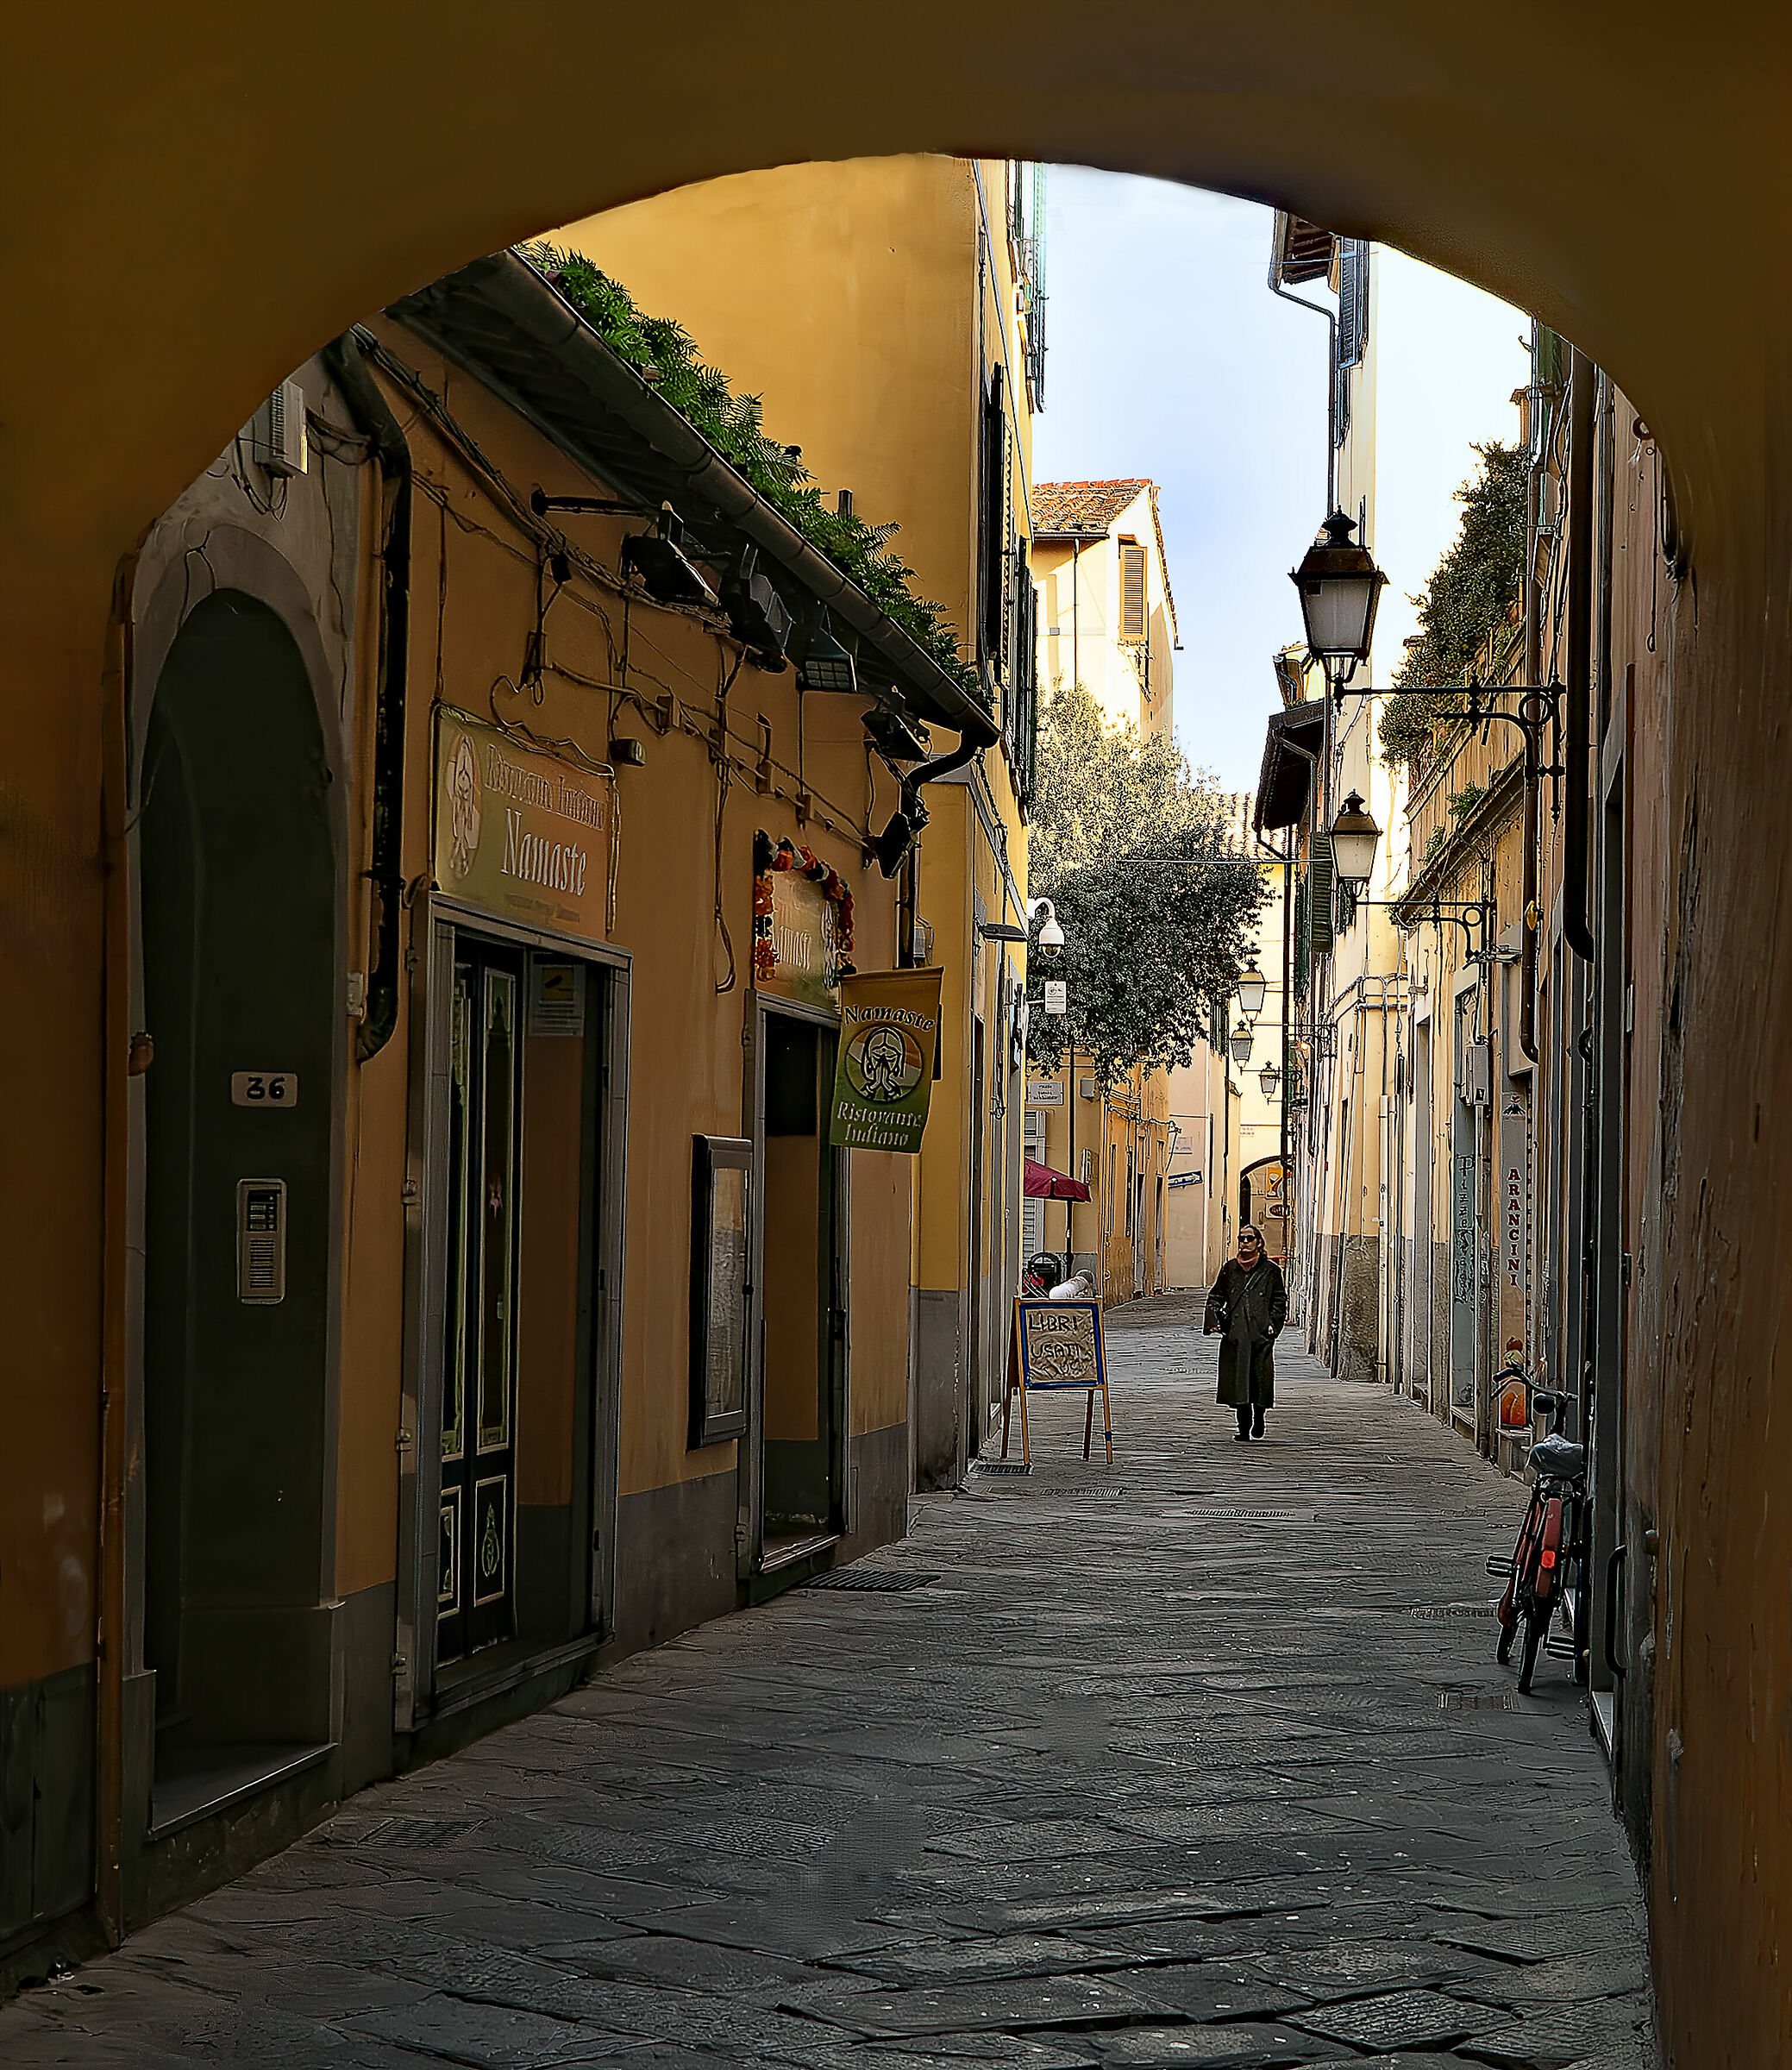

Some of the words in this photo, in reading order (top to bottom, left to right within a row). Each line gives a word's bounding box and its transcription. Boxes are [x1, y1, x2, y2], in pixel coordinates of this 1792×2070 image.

[501, 808, 586, 896] Namaste
[843, 1004, 935, 1033] Namaste
[247, 1076, 285, 1100] 36
[837, 1101, 922, 1127] Ristorante
[845, 1123, 910, 1146] Indiano
[1507, 1168, 1521, 1286] ARANCINI
[1029, 1313, 1077, 1332] LIBRI
[1031, 1343, 1081, 1359] USATI
